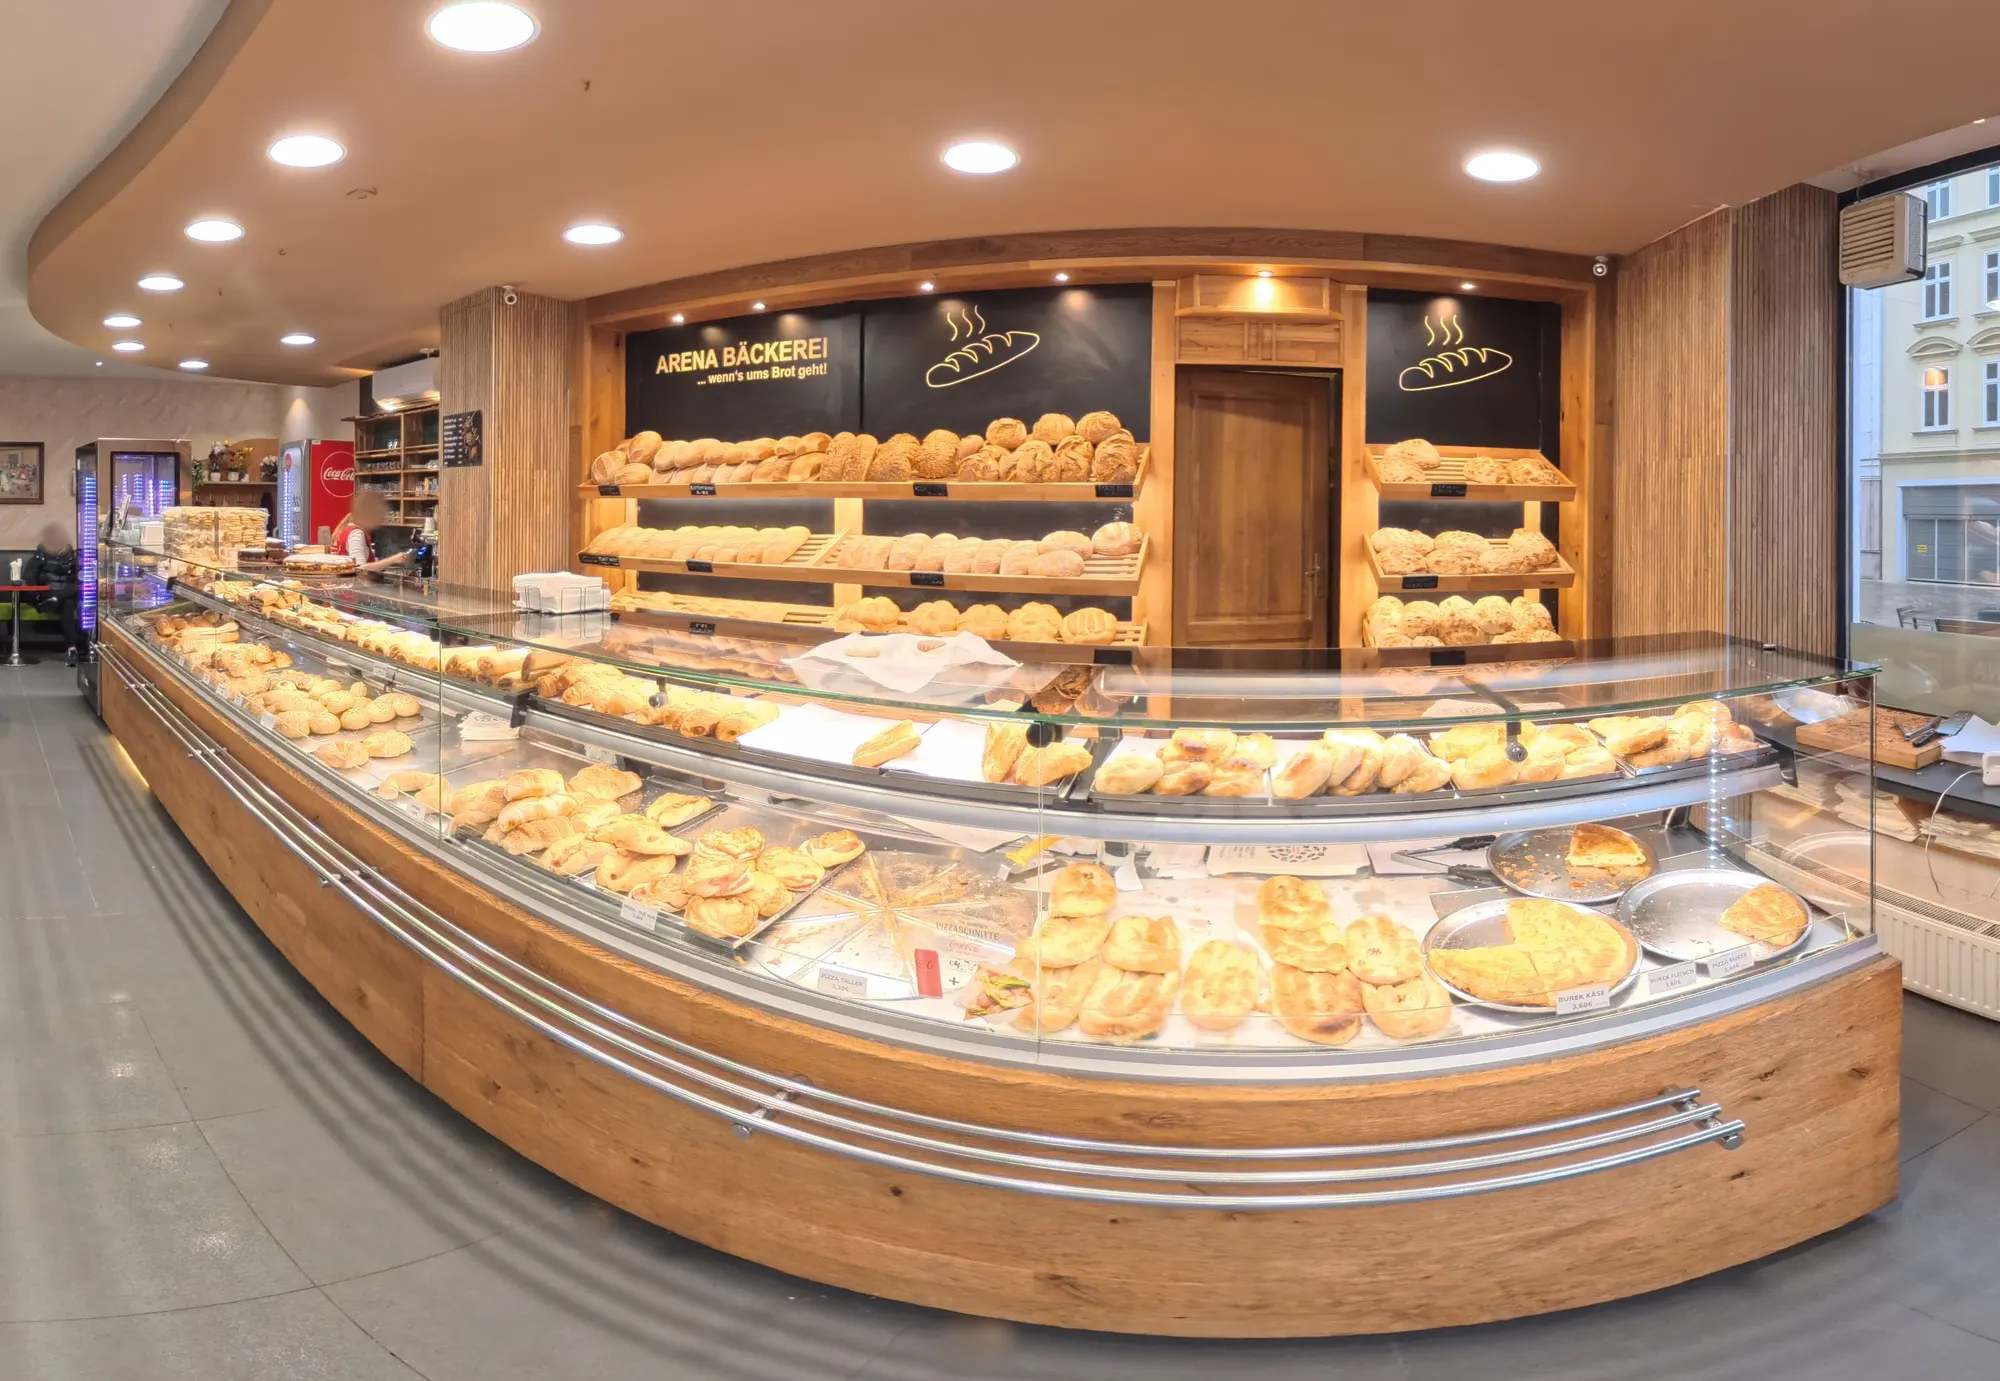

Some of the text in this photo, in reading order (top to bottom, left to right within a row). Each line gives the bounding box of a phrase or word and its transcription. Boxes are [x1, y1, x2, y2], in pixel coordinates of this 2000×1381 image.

[656, 337, 828, 374] ARENA BÄCKEREI
[708, 369, 743, 384] wenn's
[746, 369, 769, 381] ums
[772, 366, 796, 379] Brot
[798, 363, 828, 380] geht!
[936, 921, 999, 941] PIZZASCHNITTE
[821, 972, 864, 988] PIZZA TALLER
[1558, 993, 1585, 1003] BUREK
[1573, 1000, 1593, 1010] 3,60€
